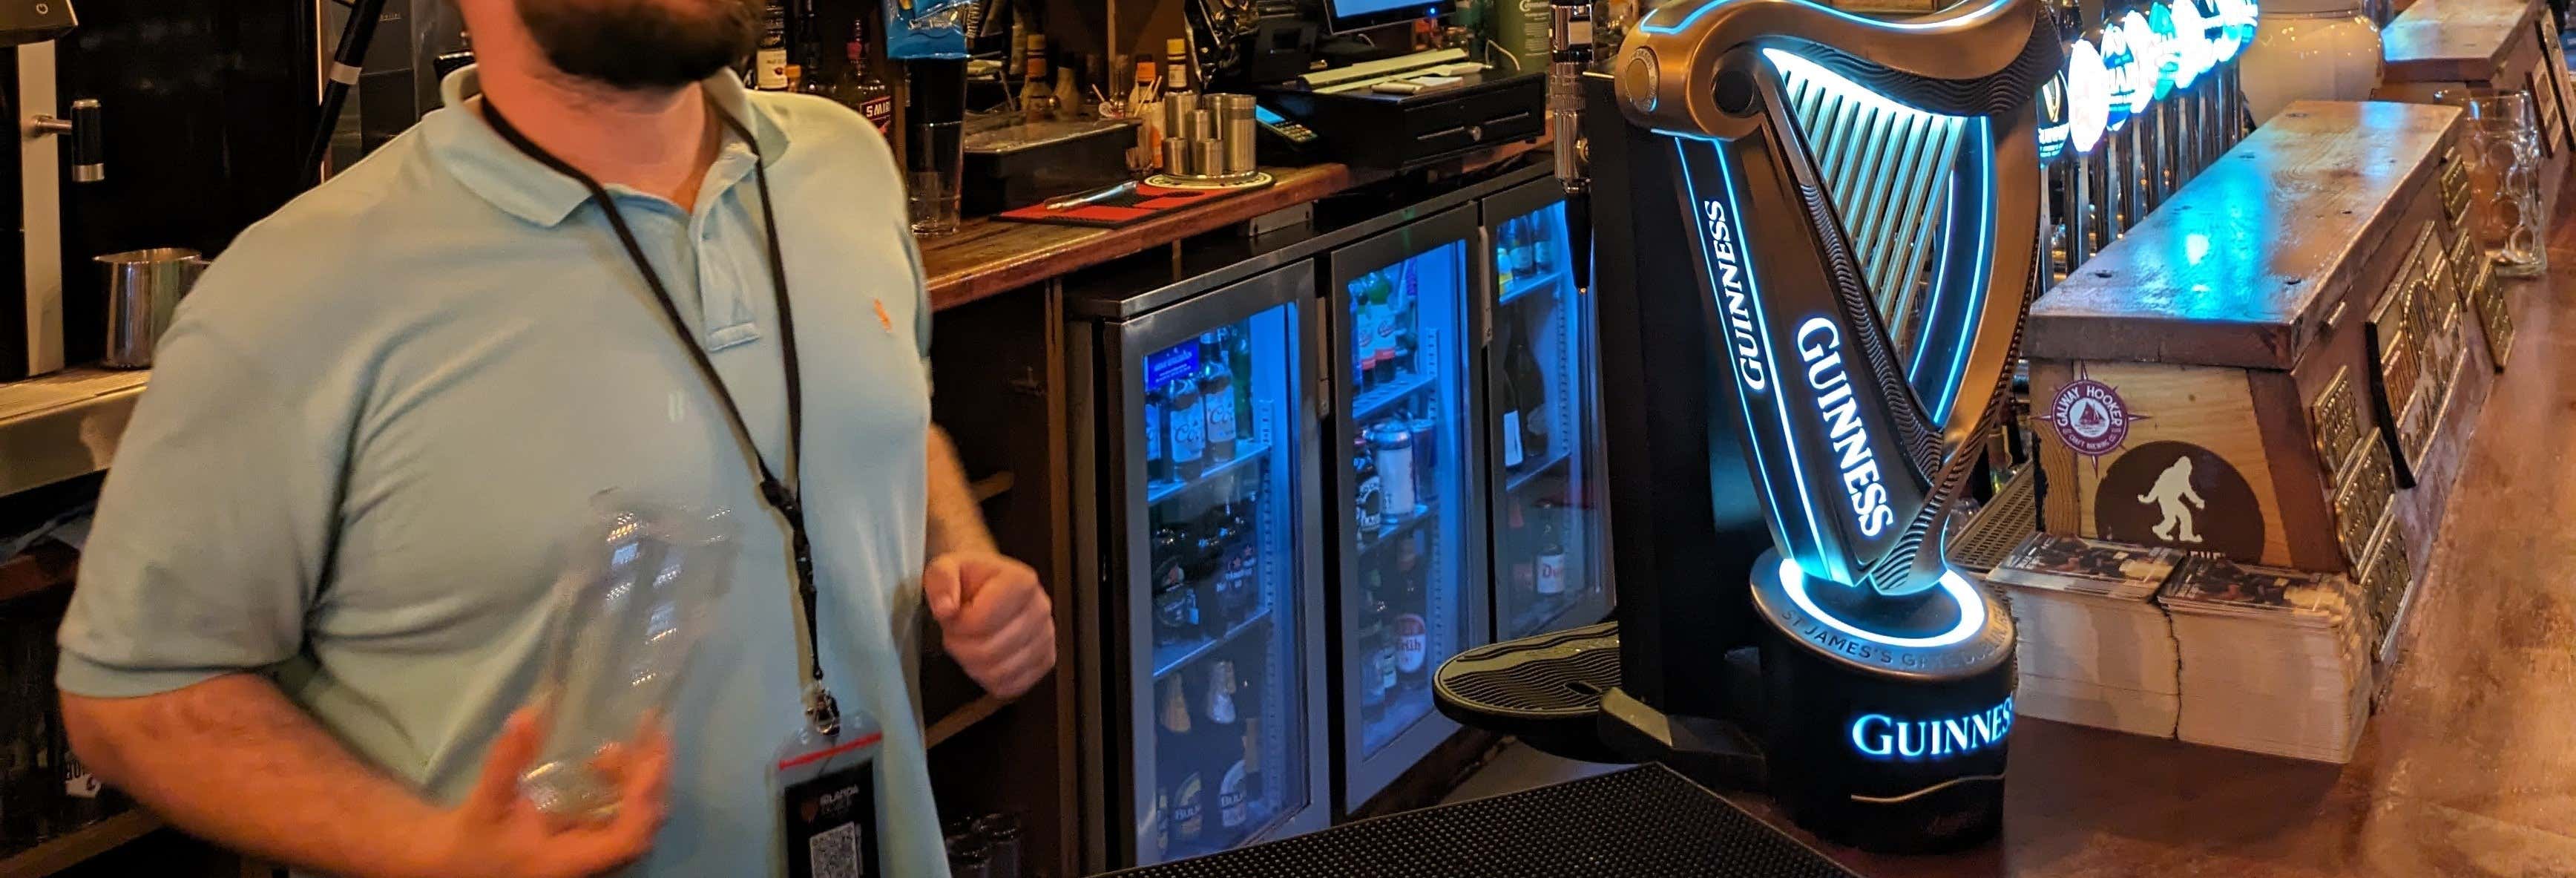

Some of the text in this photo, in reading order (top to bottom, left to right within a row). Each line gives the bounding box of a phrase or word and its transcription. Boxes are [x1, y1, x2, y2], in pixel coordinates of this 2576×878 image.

[866, 101, 891, 118] SMIR
[1704, 200, 1767, 392] GUINNESS
[1797, 317, 1893, 538] GUINNESS
[2056, 385, 2123, 427] GALWAY HOOKER
[1781, 609, 1804, 627] ST
[1804, 626, 1893, 664] JAMES'S
[1852, 696, 2013, 757] GUINNES
